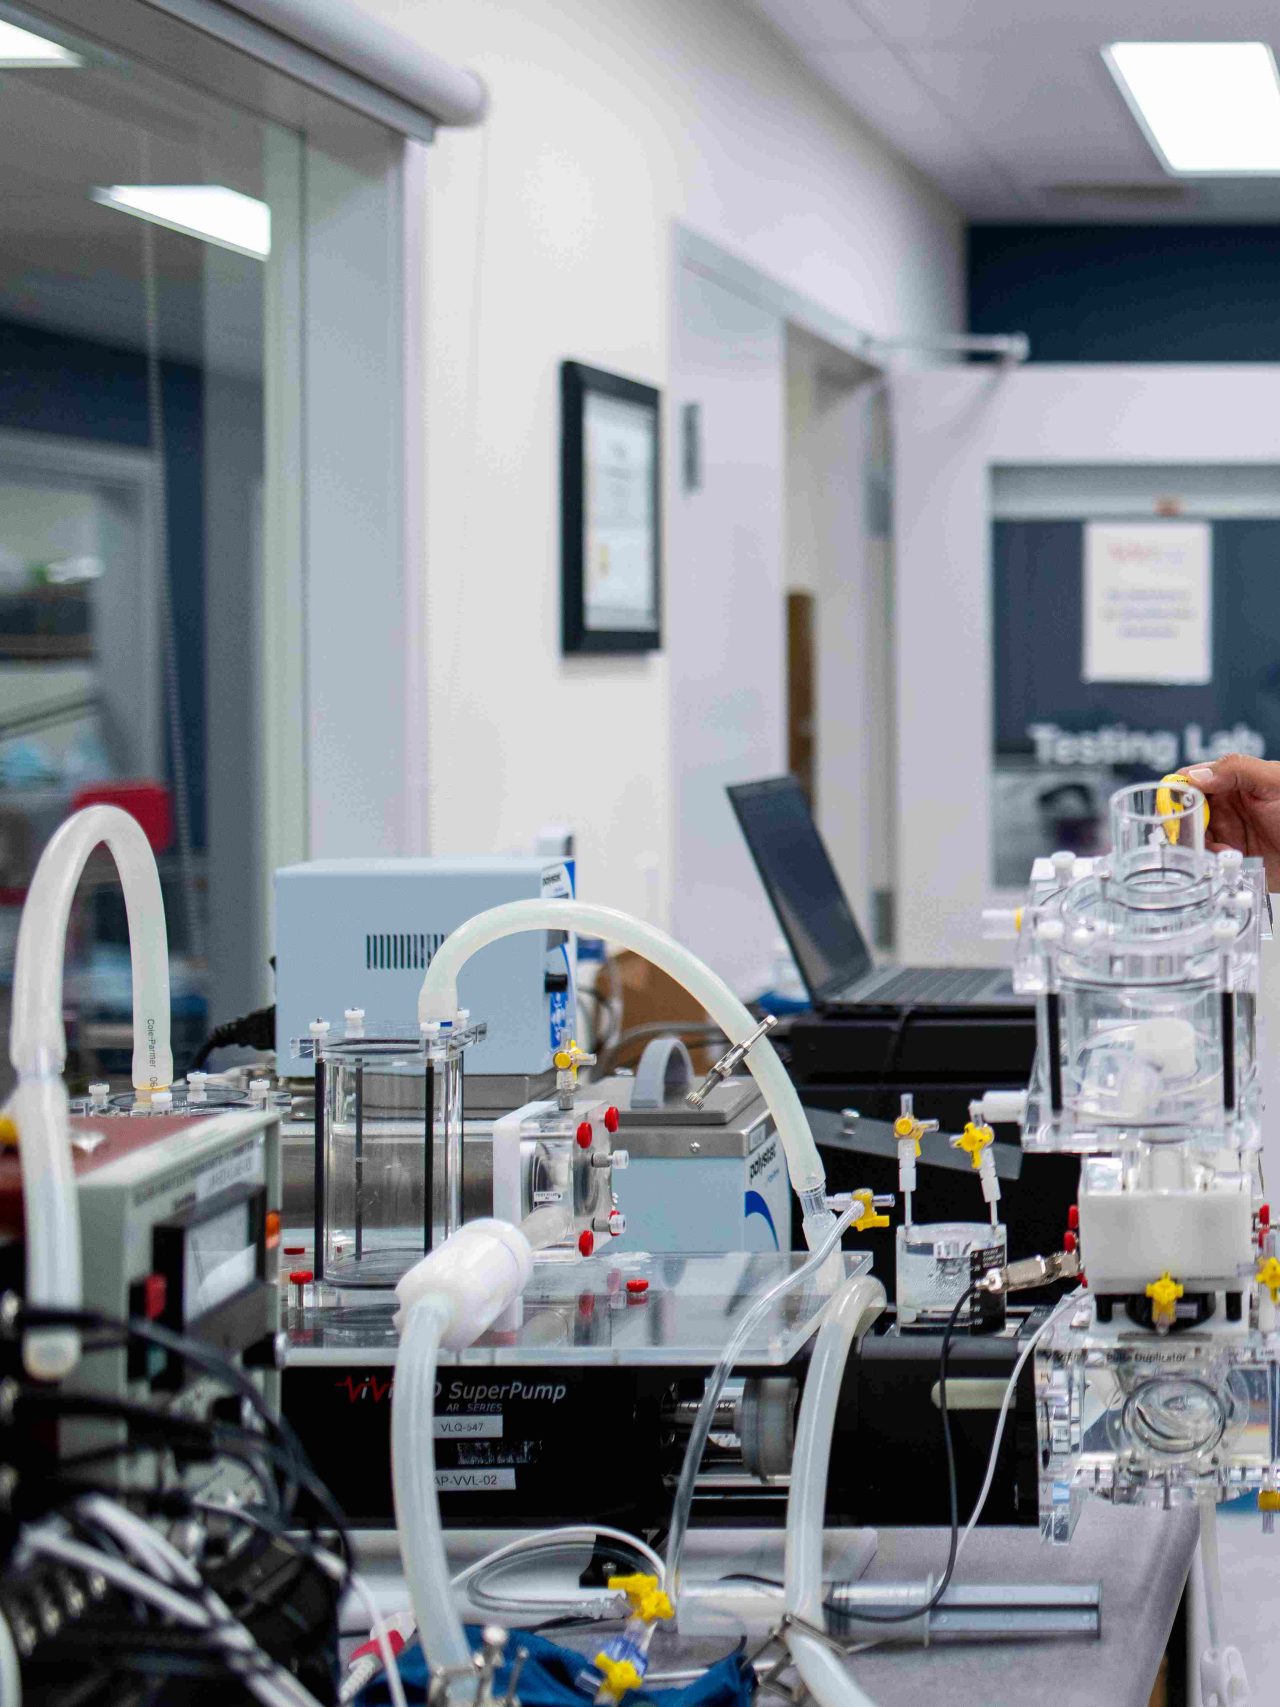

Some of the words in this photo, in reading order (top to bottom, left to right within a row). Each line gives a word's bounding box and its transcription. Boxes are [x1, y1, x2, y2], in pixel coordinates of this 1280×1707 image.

[1027, 722, 1179, 772] Testing
[1183, 722, 1266, 763] Lab
[147, 1018, 157, 1068] Cole-Parmer
[1134, 1352, 1187, 1364] Duplicator
[448, 1381, 567, 1404] SuperPump
[446, 1403, 460, 1413] AR
[467, 1402, 503, 1413] SERIES
